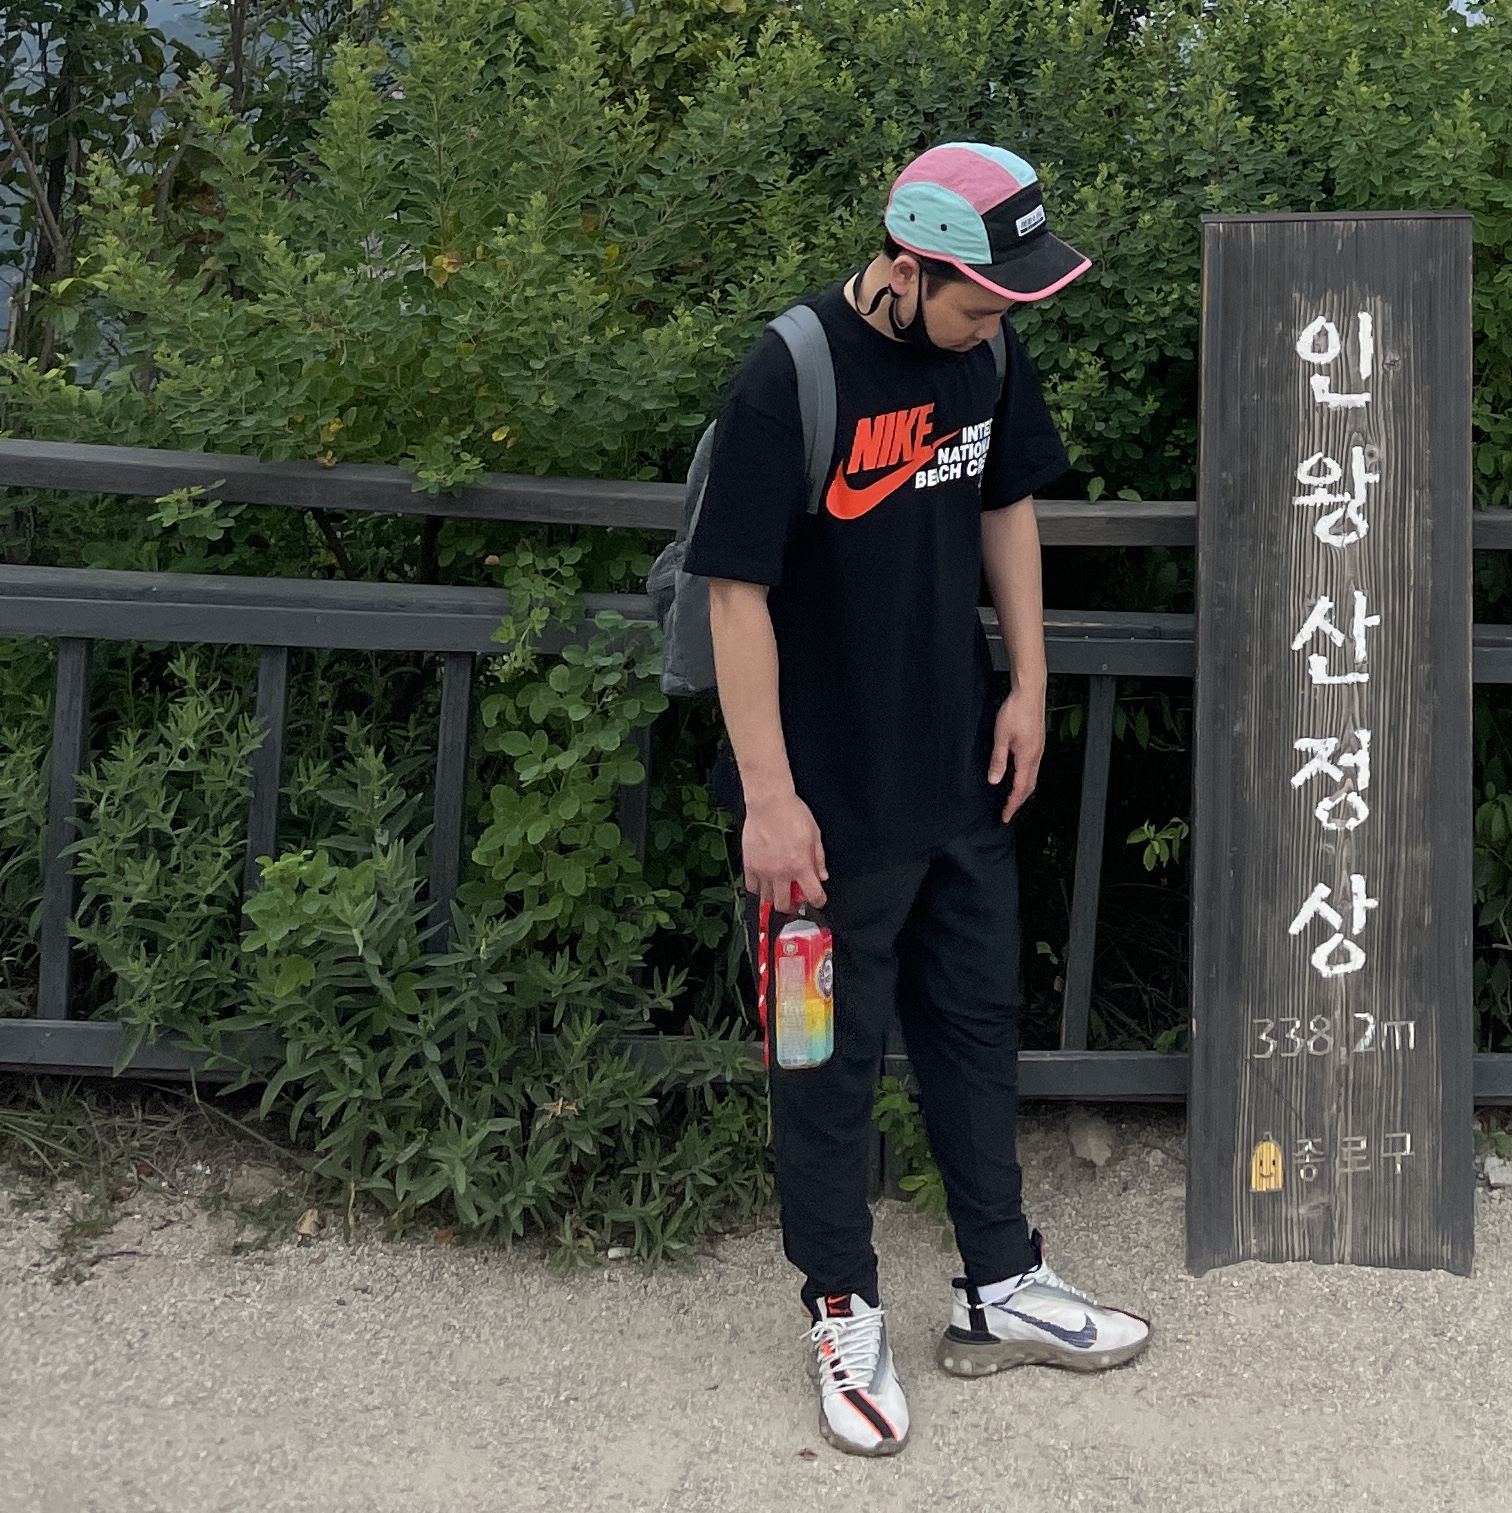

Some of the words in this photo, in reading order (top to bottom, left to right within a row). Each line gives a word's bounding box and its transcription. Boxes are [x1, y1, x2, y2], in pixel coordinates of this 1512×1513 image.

[847, 402, 935, 475] NIKE
[1288, 311, 1382, 978] 인왕산정상
[1252, 1012, 1416, 1064] 338.2m
[1293, 1133, 1415, 1182] 종로구
